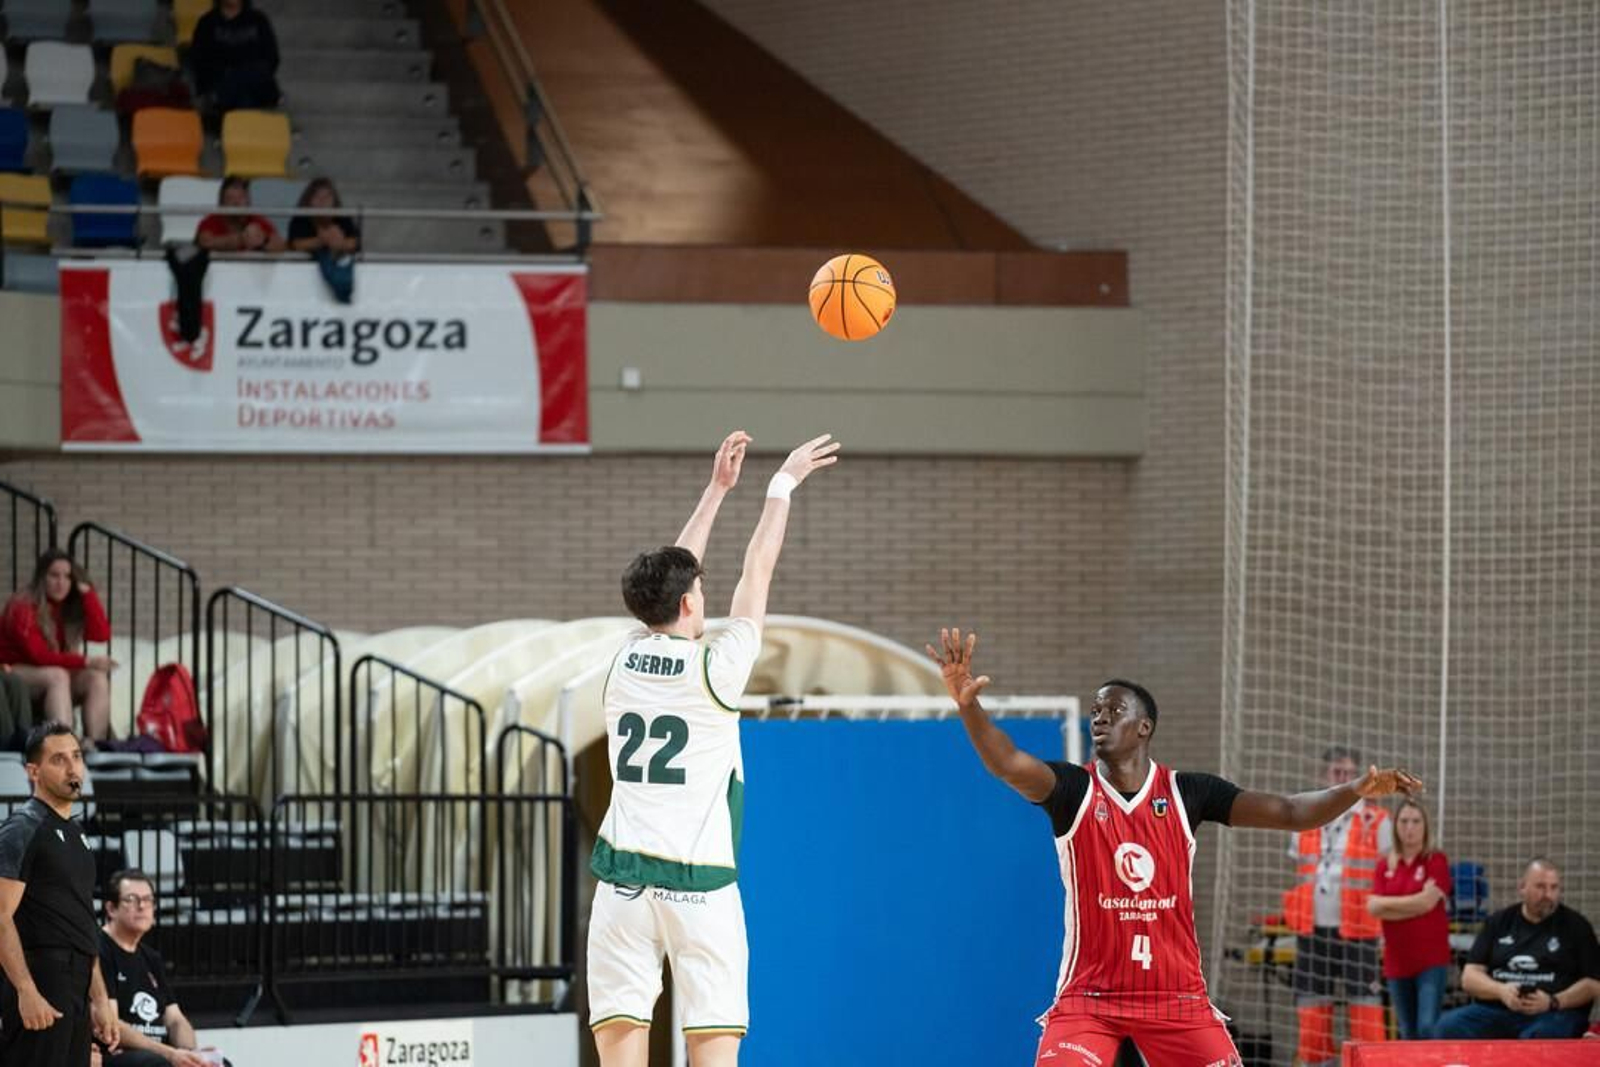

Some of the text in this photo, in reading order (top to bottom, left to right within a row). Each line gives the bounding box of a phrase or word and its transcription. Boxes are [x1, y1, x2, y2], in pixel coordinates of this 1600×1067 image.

[236, 306, 468, 367] Zaragoza
[237, 377, 432, 402] INSTALACIONES
[237, 402, 396, 430] DEPORTIVAS
[624, 652, 685, 677] SIERRA
[616, 711, 690, 786] 22
[1131, 934, 1153, 970] 4
[385, 1036, 471, 1067] Zaragoza
